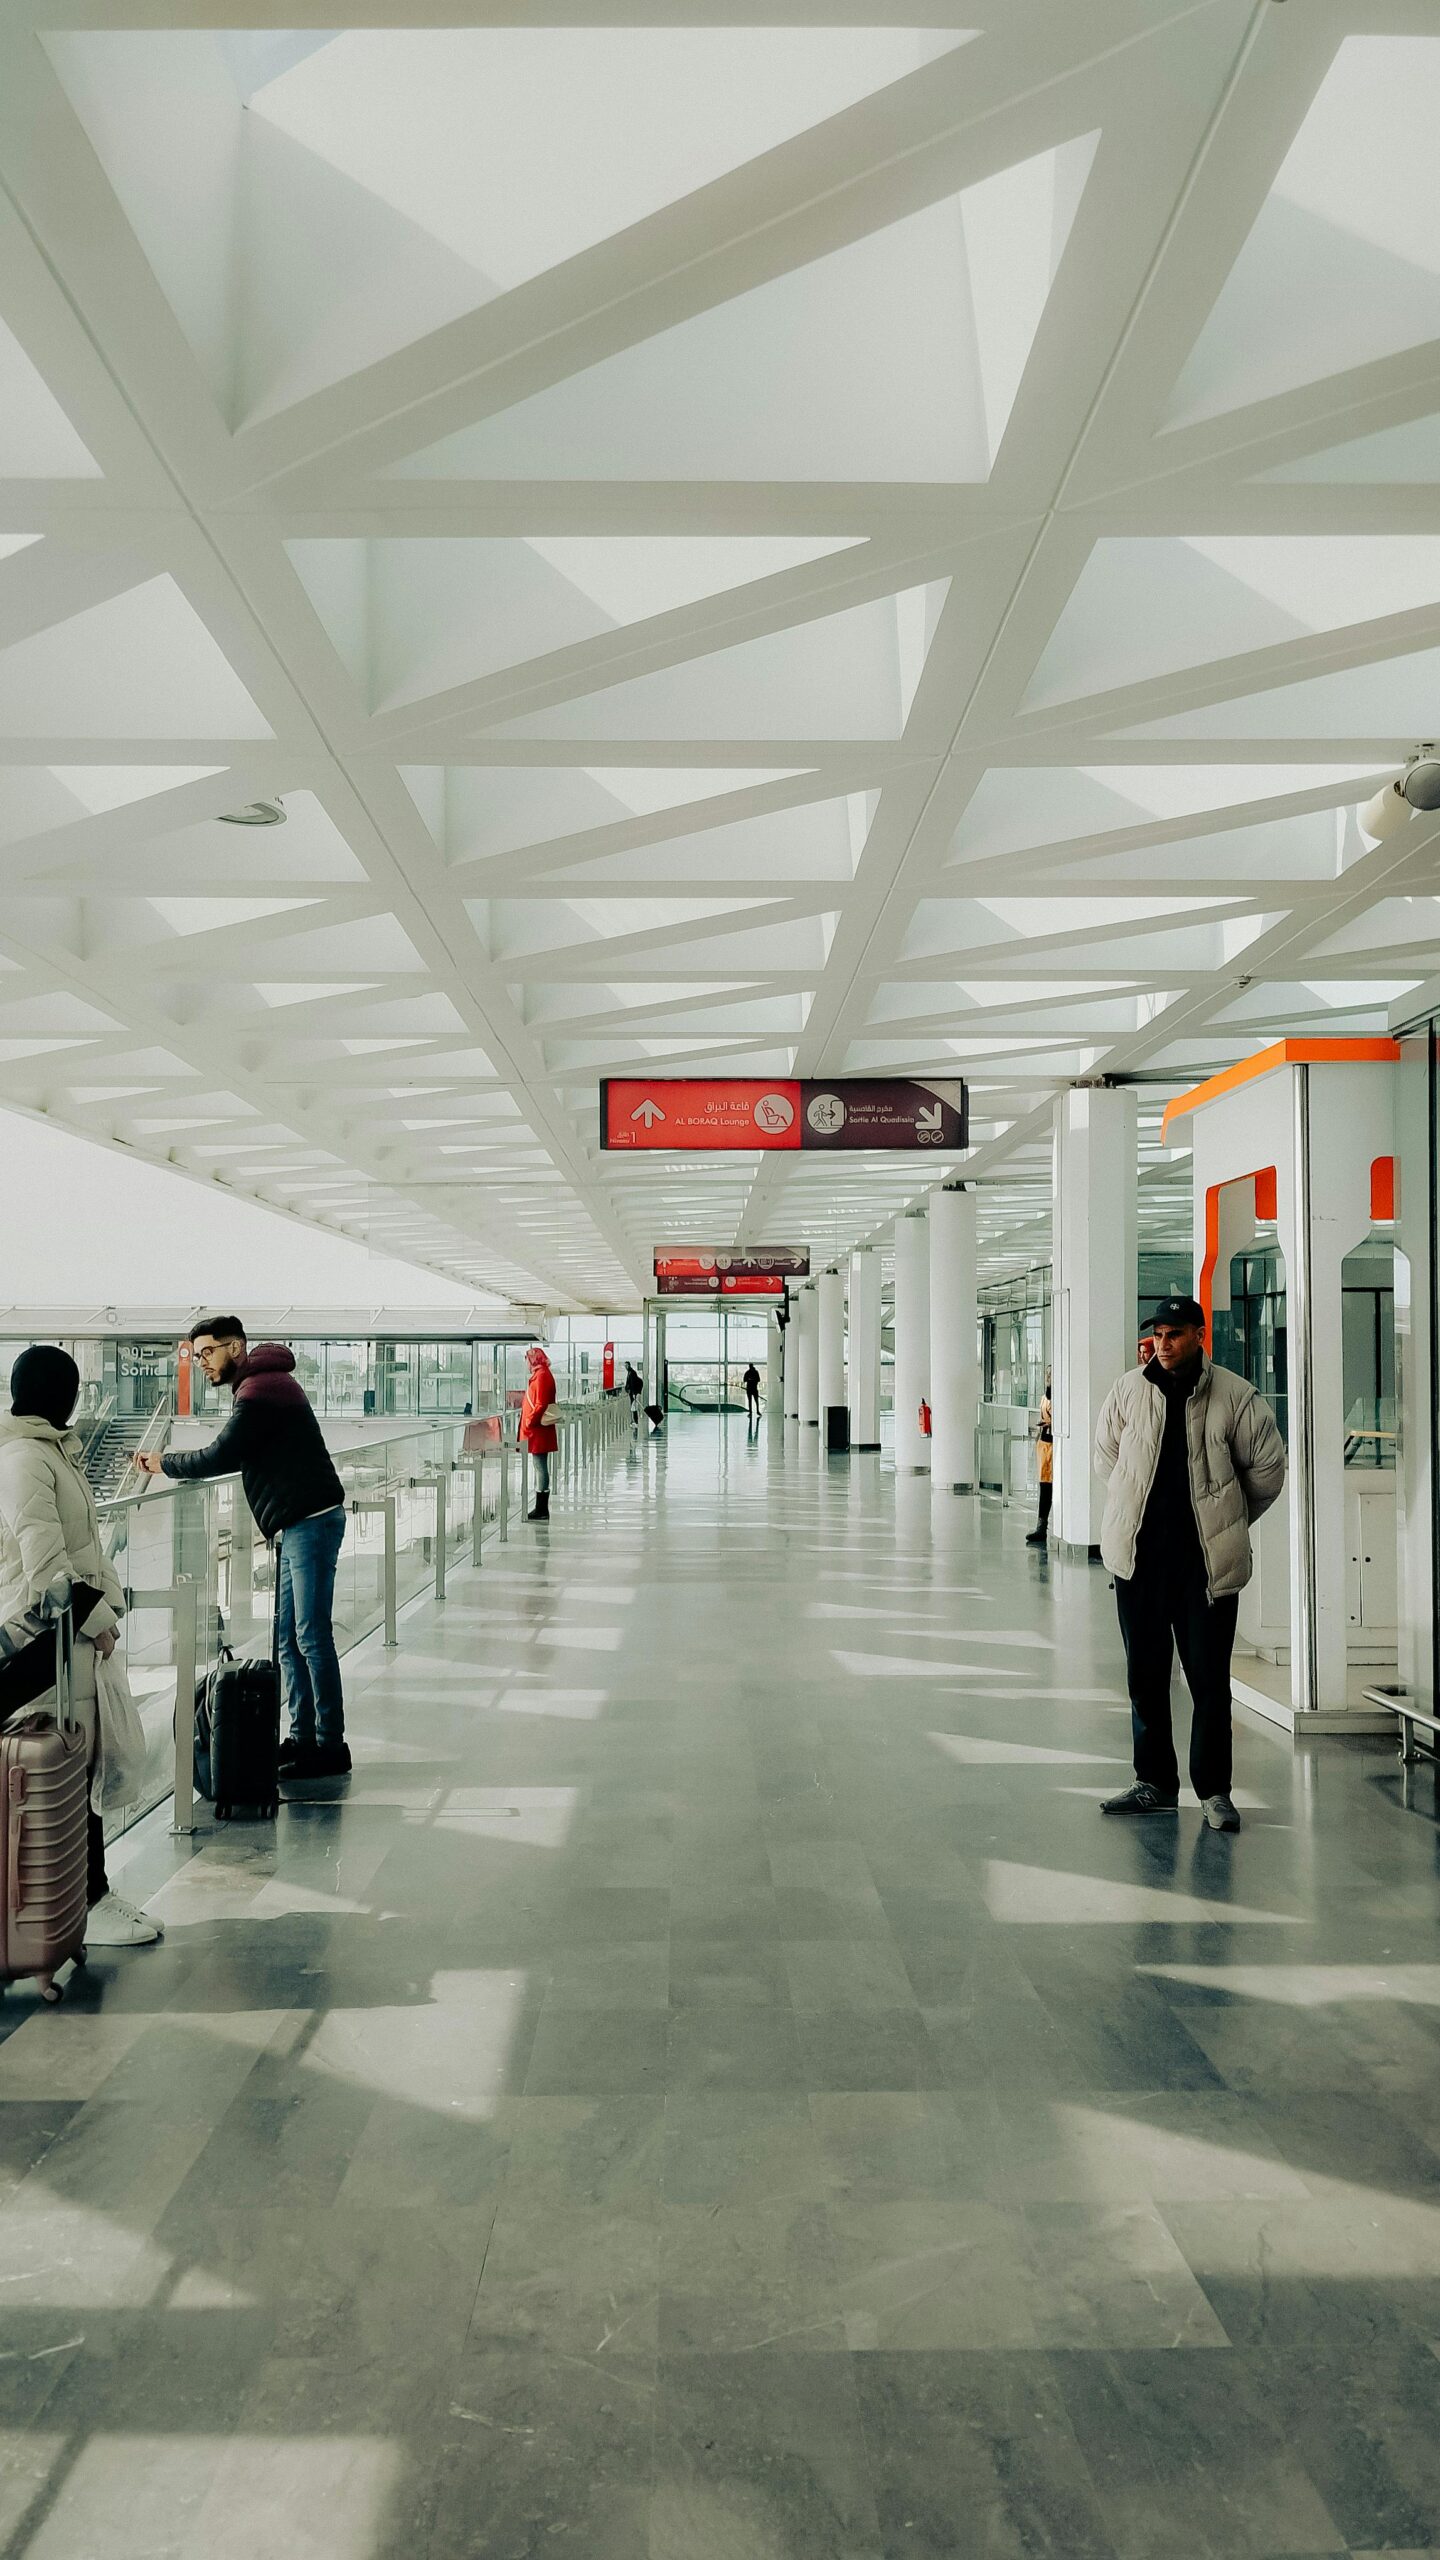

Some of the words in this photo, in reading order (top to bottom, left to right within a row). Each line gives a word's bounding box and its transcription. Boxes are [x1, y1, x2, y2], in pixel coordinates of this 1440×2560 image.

[704, 1101, 728, 1114] البراق
[730, 1101, 750, 1111] قاعة
[675, 1117, 686, 1126] AL
[687, 1117, 718, 1126] BORAQ
[720, 1117, 750, 1127] Lounge
[849, 1116, 870, 1124] Sortie
[871, 1116, 879, 1124] Al
[880, 1116, 915, 1124] Quadissia
